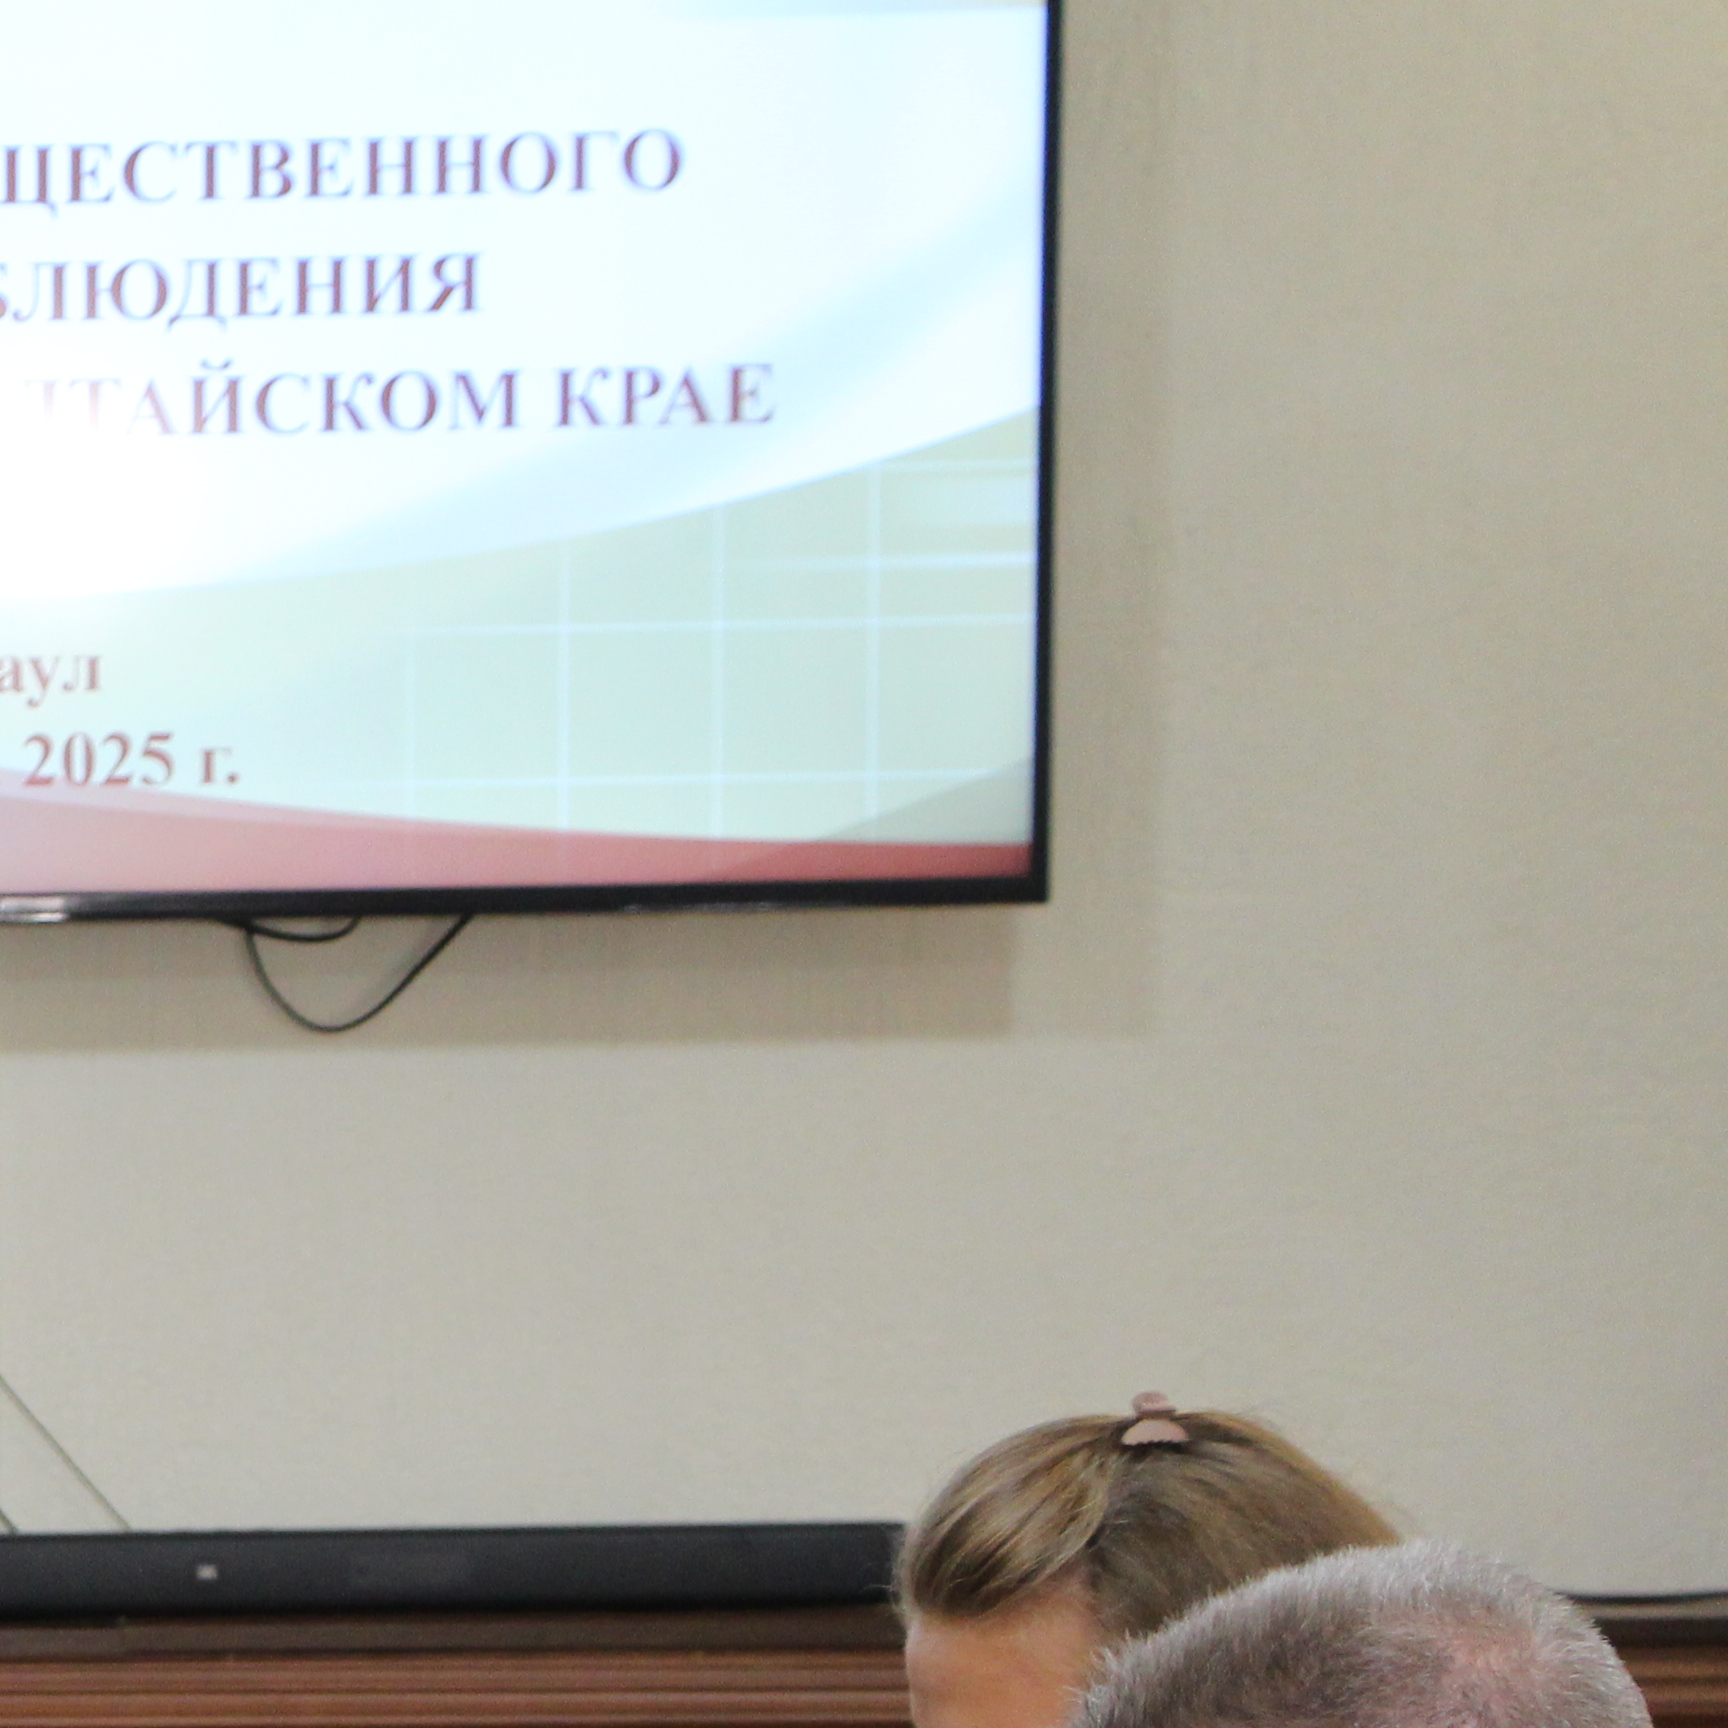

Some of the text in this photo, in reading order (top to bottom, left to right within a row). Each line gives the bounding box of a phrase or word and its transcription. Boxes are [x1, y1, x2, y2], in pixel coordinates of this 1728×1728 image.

[554, 362, 775, 429] КРАЕ
[22, 731, 174, 786] 2025
[199, 747, 240, 785] г.
